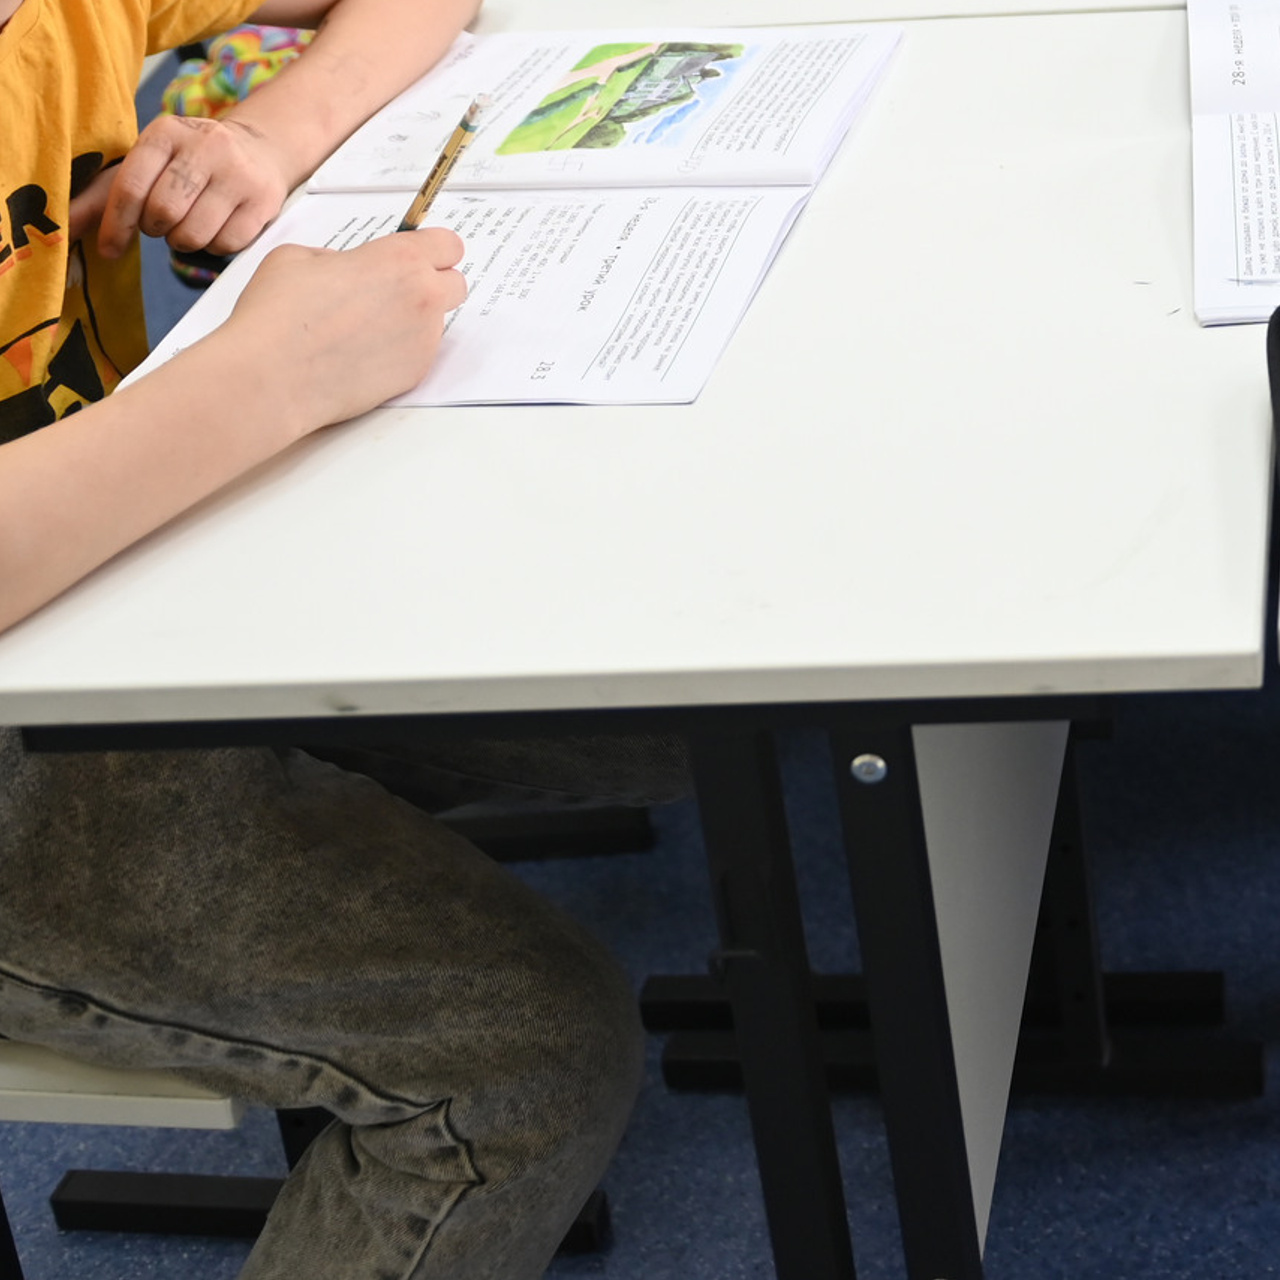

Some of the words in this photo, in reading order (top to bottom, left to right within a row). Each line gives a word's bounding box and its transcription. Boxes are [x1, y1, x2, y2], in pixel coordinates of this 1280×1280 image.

[1231, 60, 1246, 85] 28-я
[592, 254, 618, 285] третий
[576, 288, 597, 311] урок
